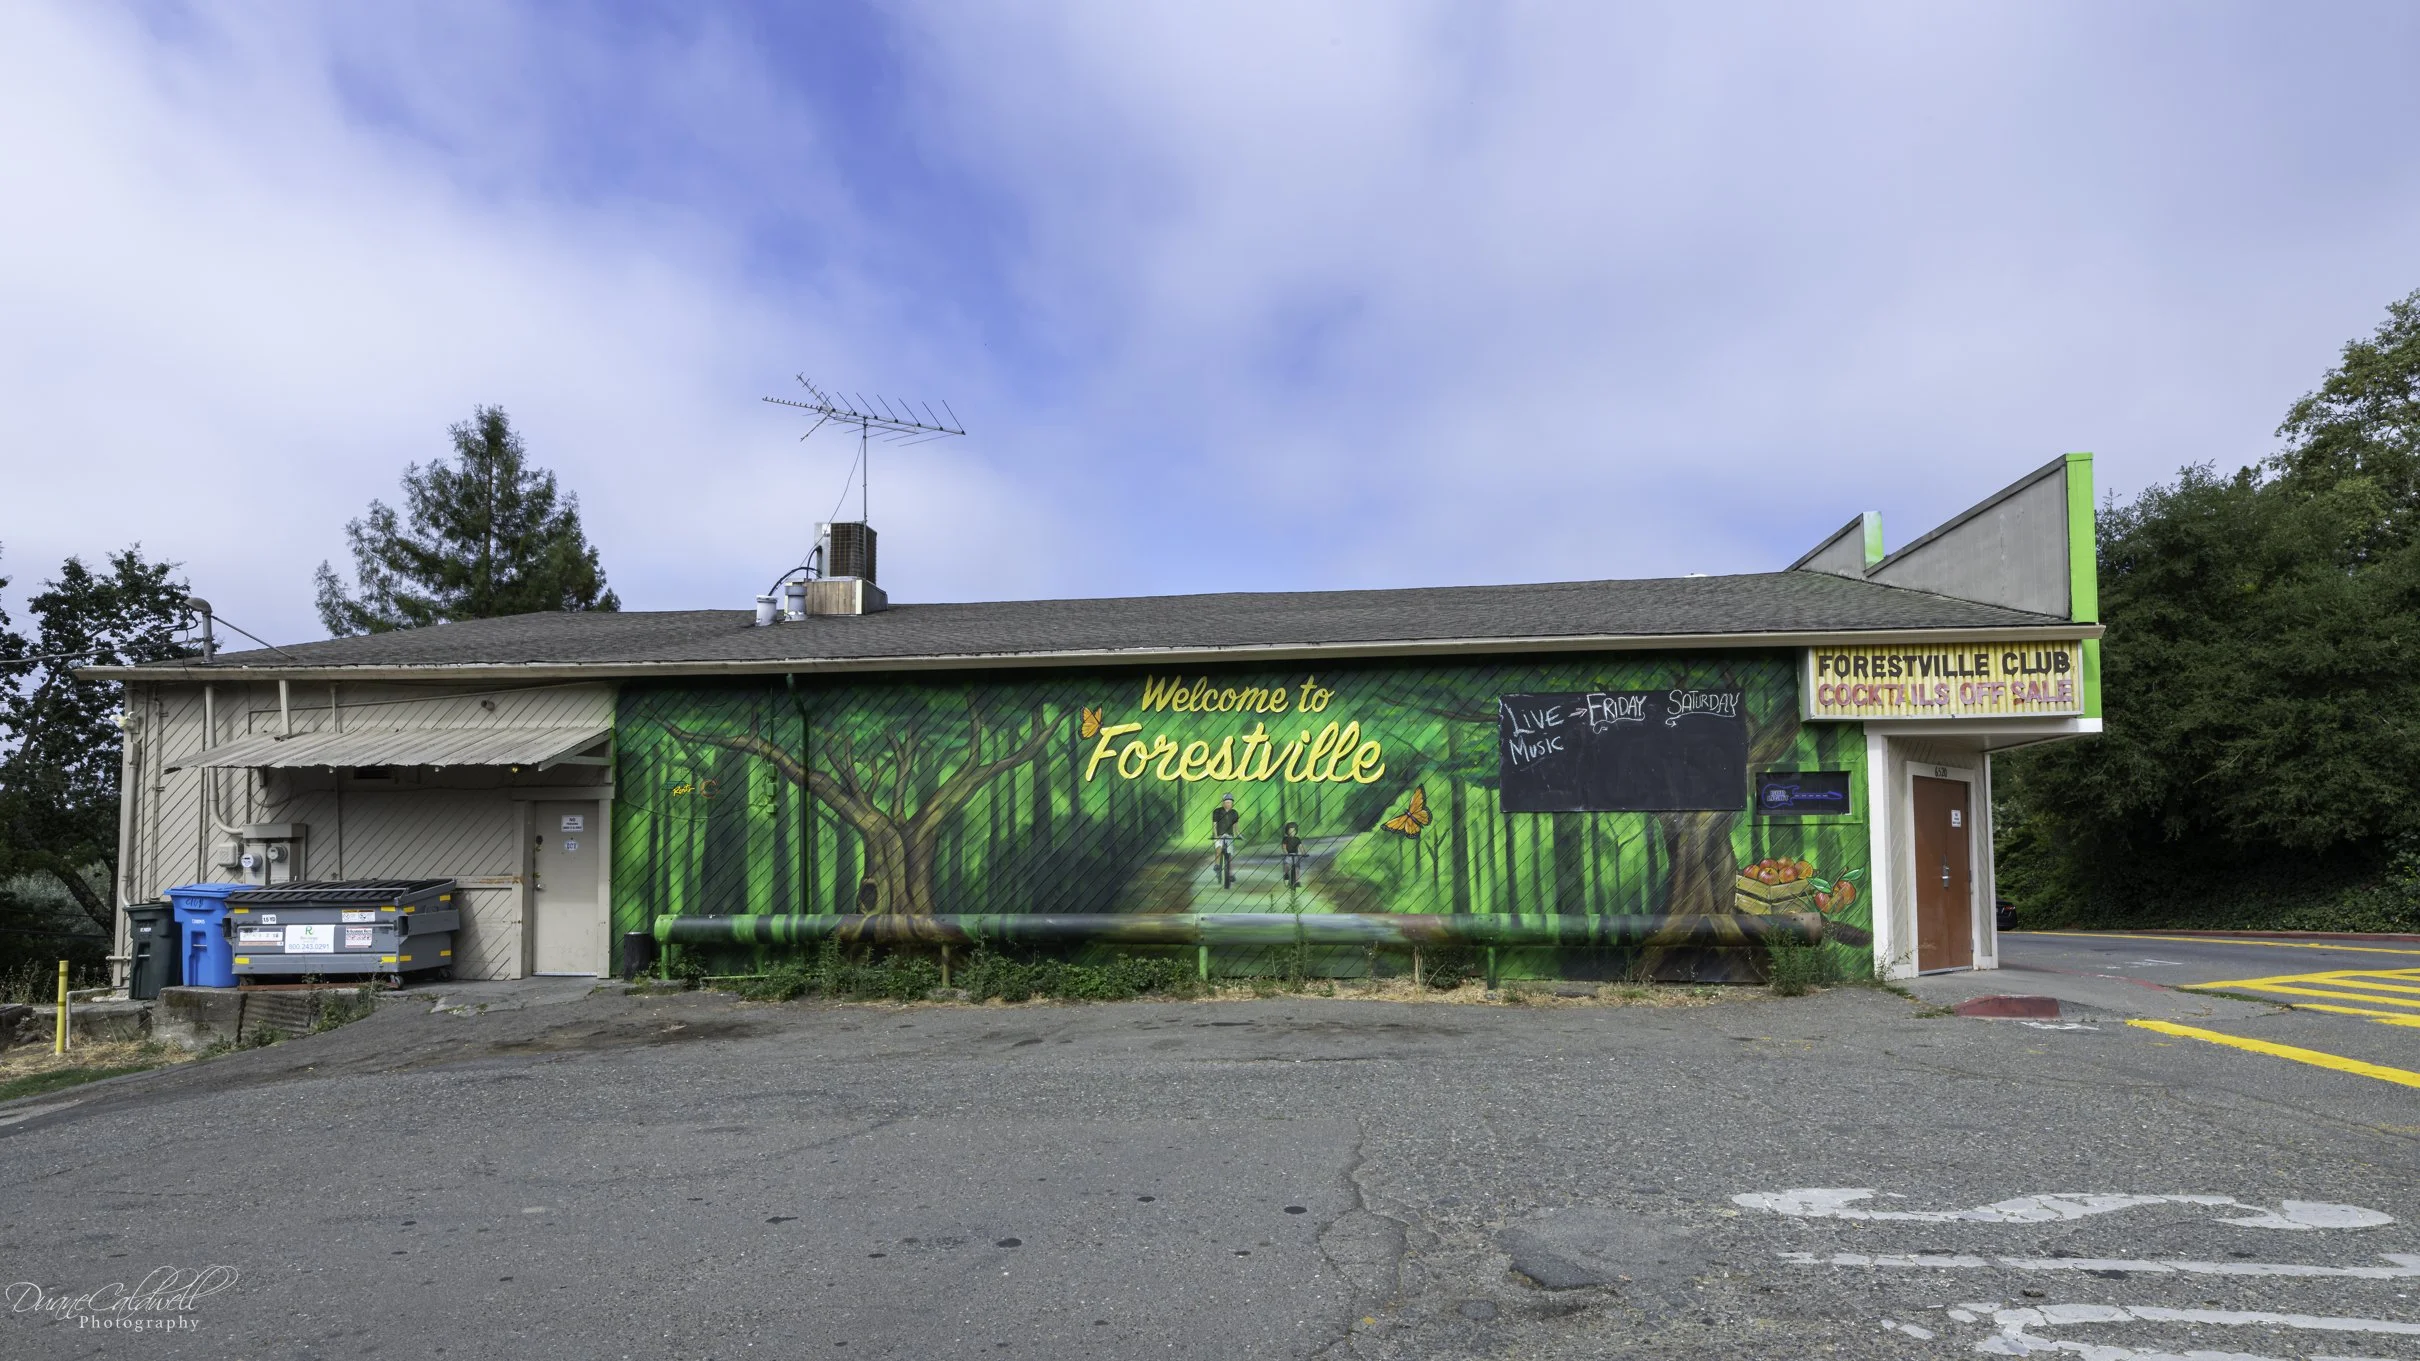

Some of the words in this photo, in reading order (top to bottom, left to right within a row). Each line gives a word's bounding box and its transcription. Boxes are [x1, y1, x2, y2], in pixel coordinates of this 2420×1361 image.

[1818, 653, 1990, 678] FORESTVILLE
[2002, 650, 2071, 676] CLUB
[1141, 674, 1288, 713] Welcome
[1298, 674, 1334, 713] to
[1586, 693, 1647, 726] FRIDAY
[1667, 689, 1740, 717] SATURDAY
[1818, 683, 1951, 707] COCKTAILS
[1959, 681, 2006, 706] OFF
[2010, 679, 2074, 706] SALE
[1085, 720, 1386, 784] Forestville
[1934, 766, 1948, 778] 6520
